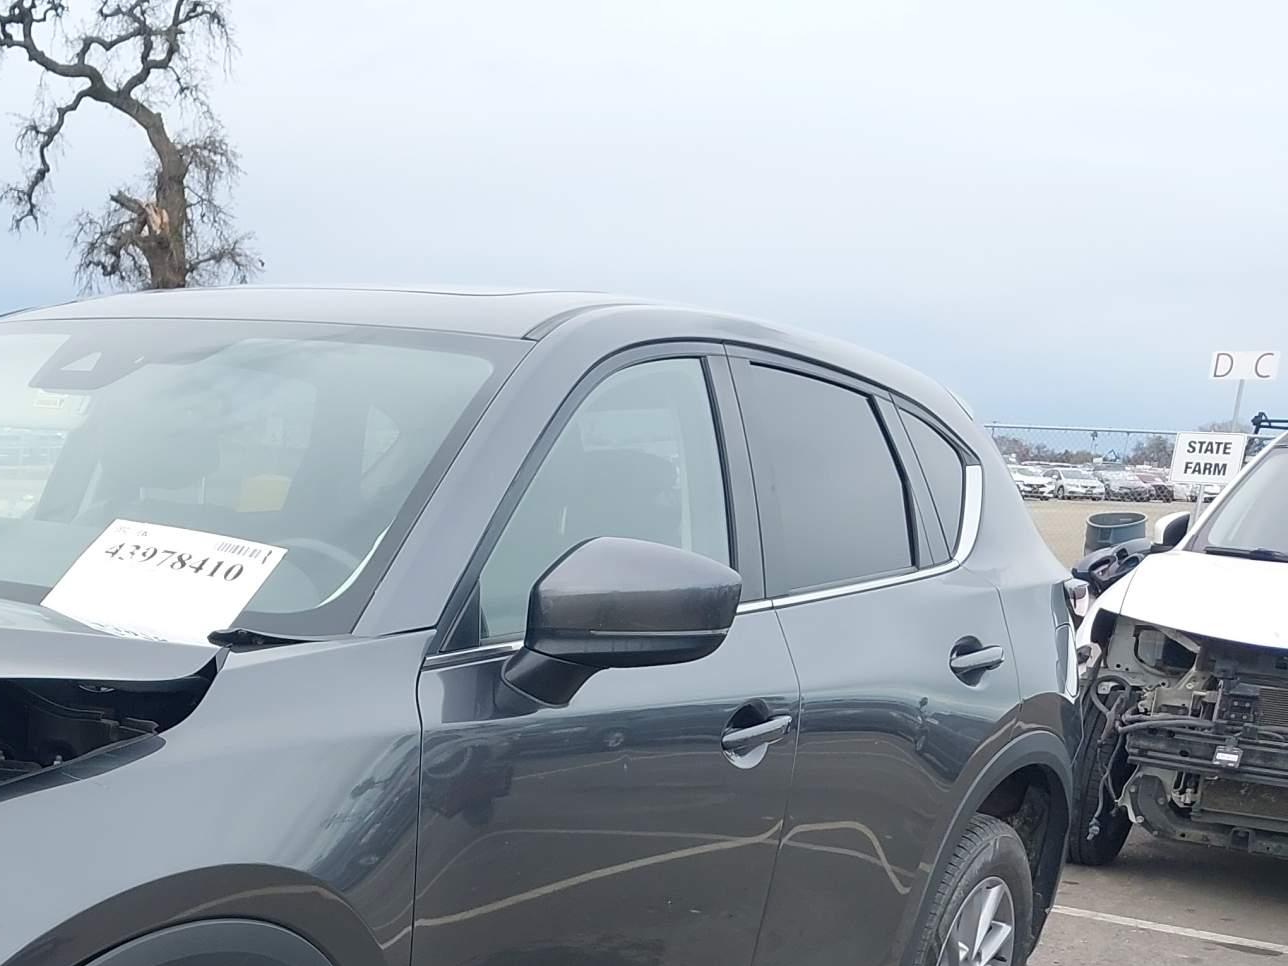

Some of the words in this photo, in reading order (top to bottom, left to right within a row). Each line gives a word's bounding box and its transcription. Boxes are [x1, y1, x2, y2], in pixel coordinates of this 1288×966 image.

[1213, 352, 1234, 378] D
[1254, 352, 1275, 378] C
[1186, 440, 1233, 455] STATE
[1183, 461, 1228, 476] FARM
[104, 541, 245, 582] 43978410
